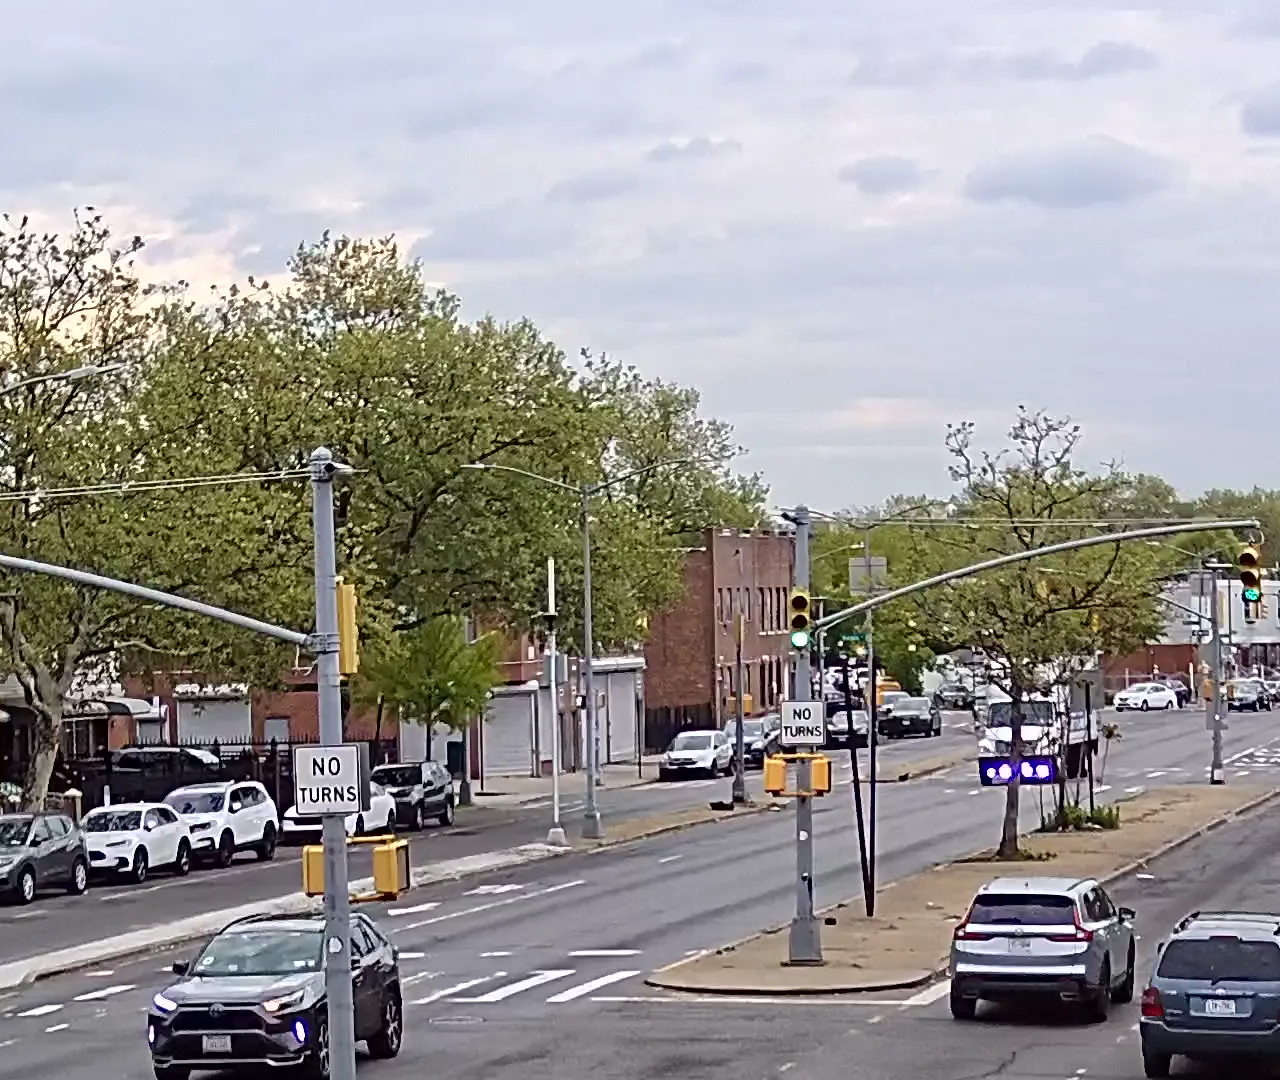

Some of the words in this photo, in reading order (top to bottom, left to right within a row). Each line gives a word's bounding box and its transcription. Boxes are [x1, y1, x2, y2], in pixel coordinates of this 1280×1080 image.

[792, 707, 812, 721] NO
[783, 725, 822, 738] TURNS
[312, 756, 341, 776] NO
[299, 785, 357, 803] TURNS
